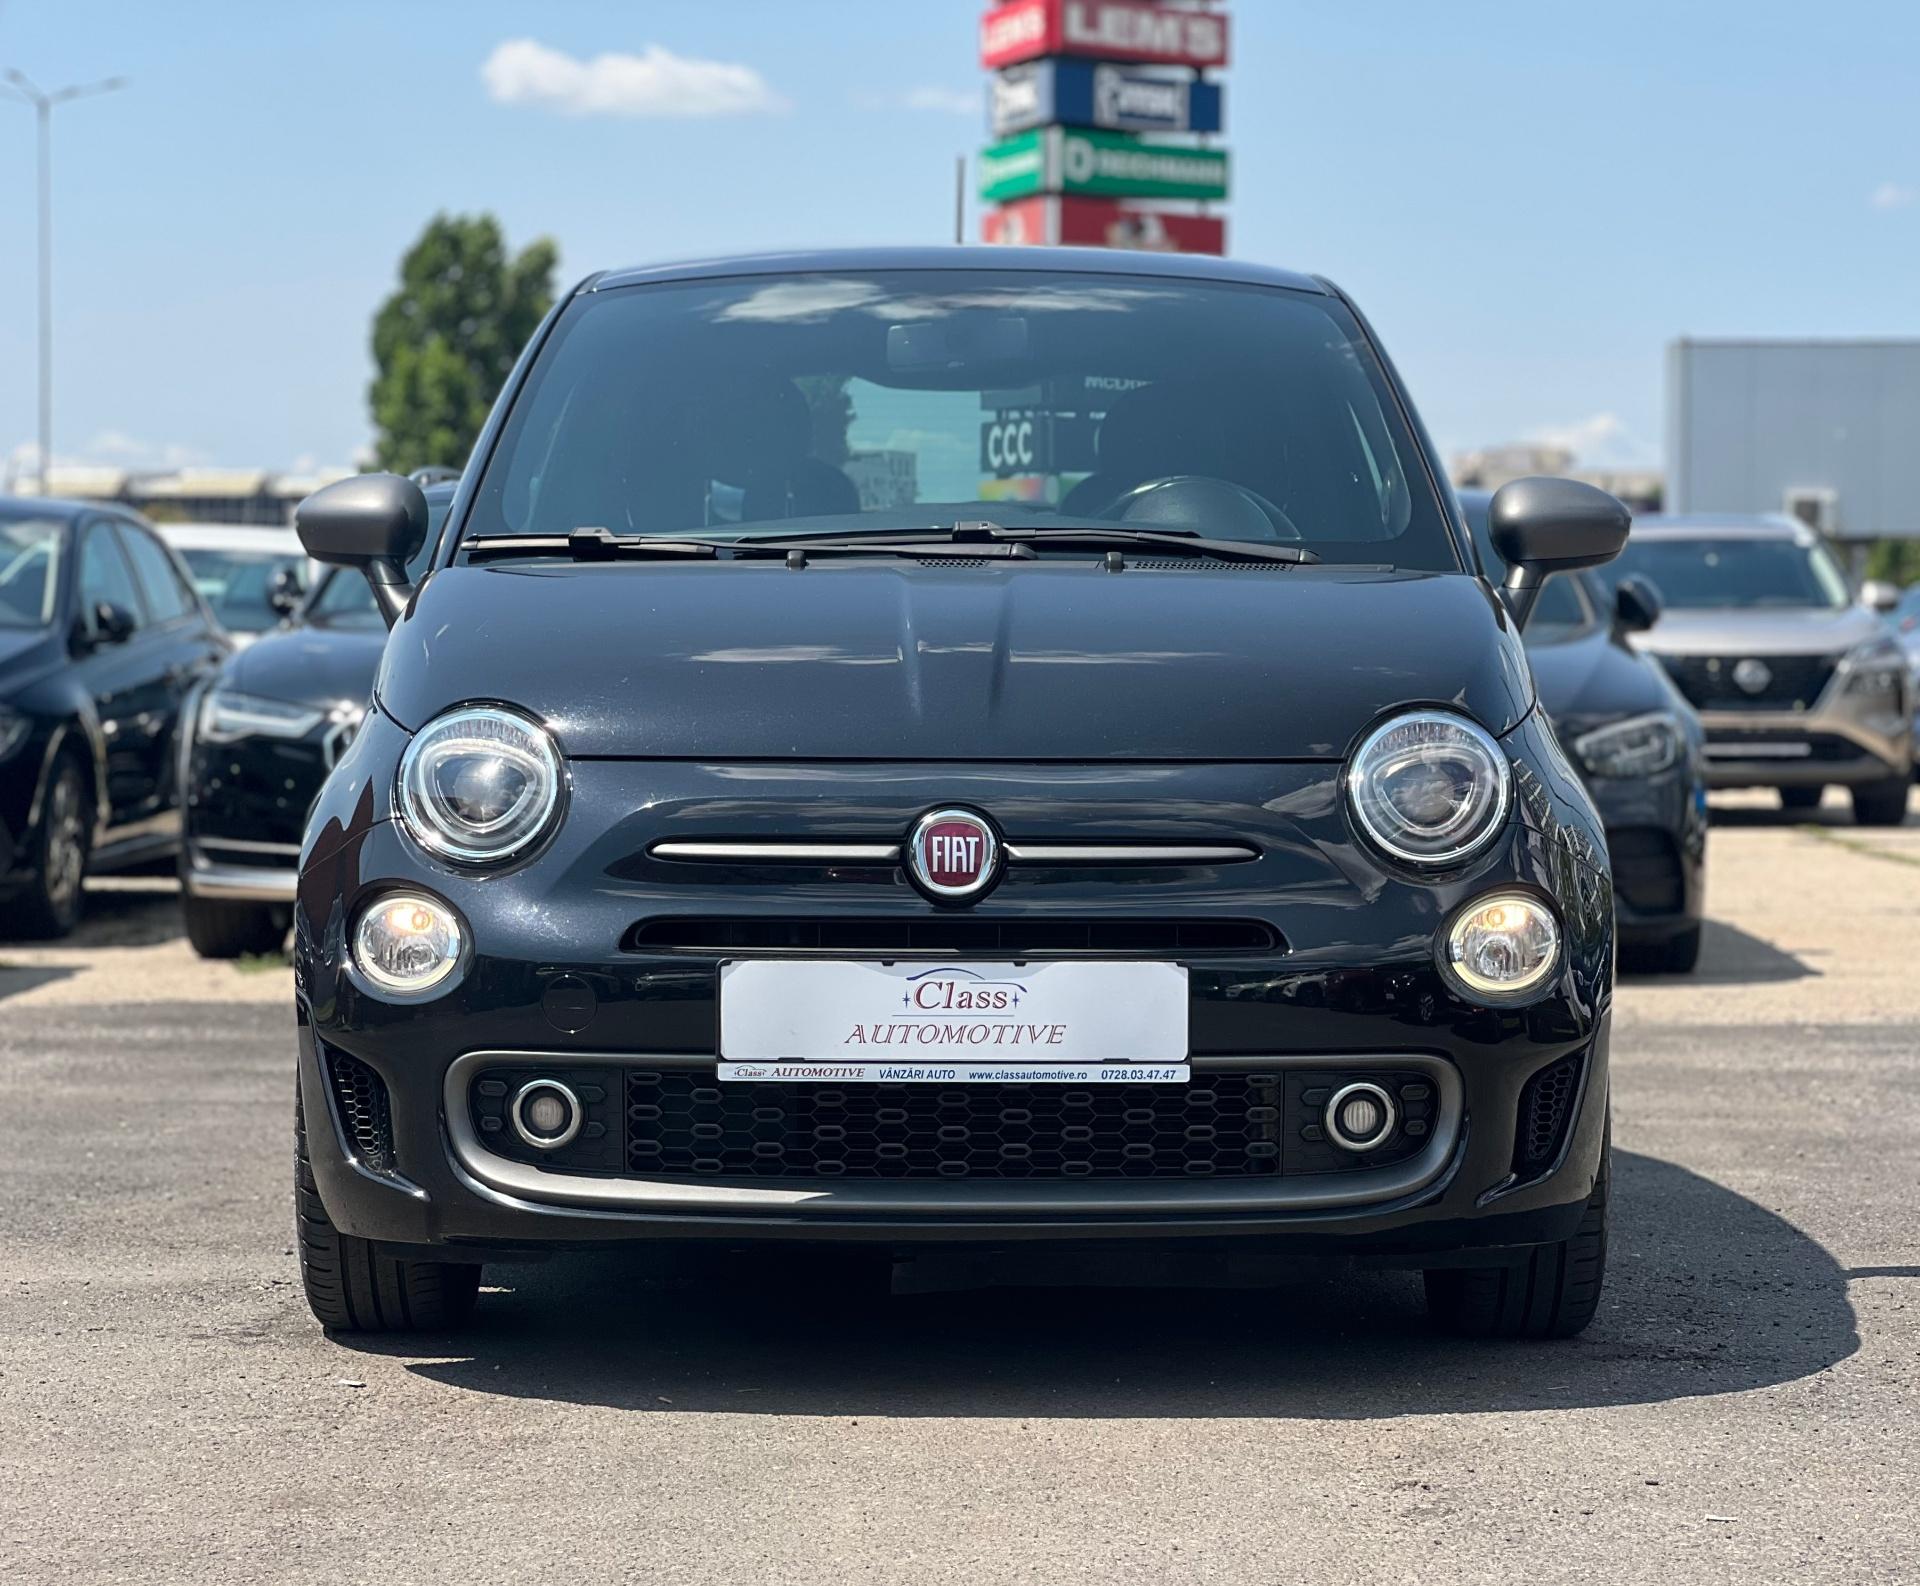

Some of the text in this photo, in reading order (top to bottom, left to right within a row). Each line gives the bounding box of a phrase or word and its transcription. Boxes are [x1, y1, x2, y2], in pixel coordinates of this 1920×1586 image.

[988, 421, 1032, 467] CCC
[932, 836, 979, 873] FIAT
[914, 981, 1008, 1009] Class
[845, 1024, 1066, 1044] AUTOMOTIVE
[735, 1067, 1176, 1080] Class AUTOMOTIVE VÂNZĂRI AUTO www.classautomotive.ro 0728.03.47.47
